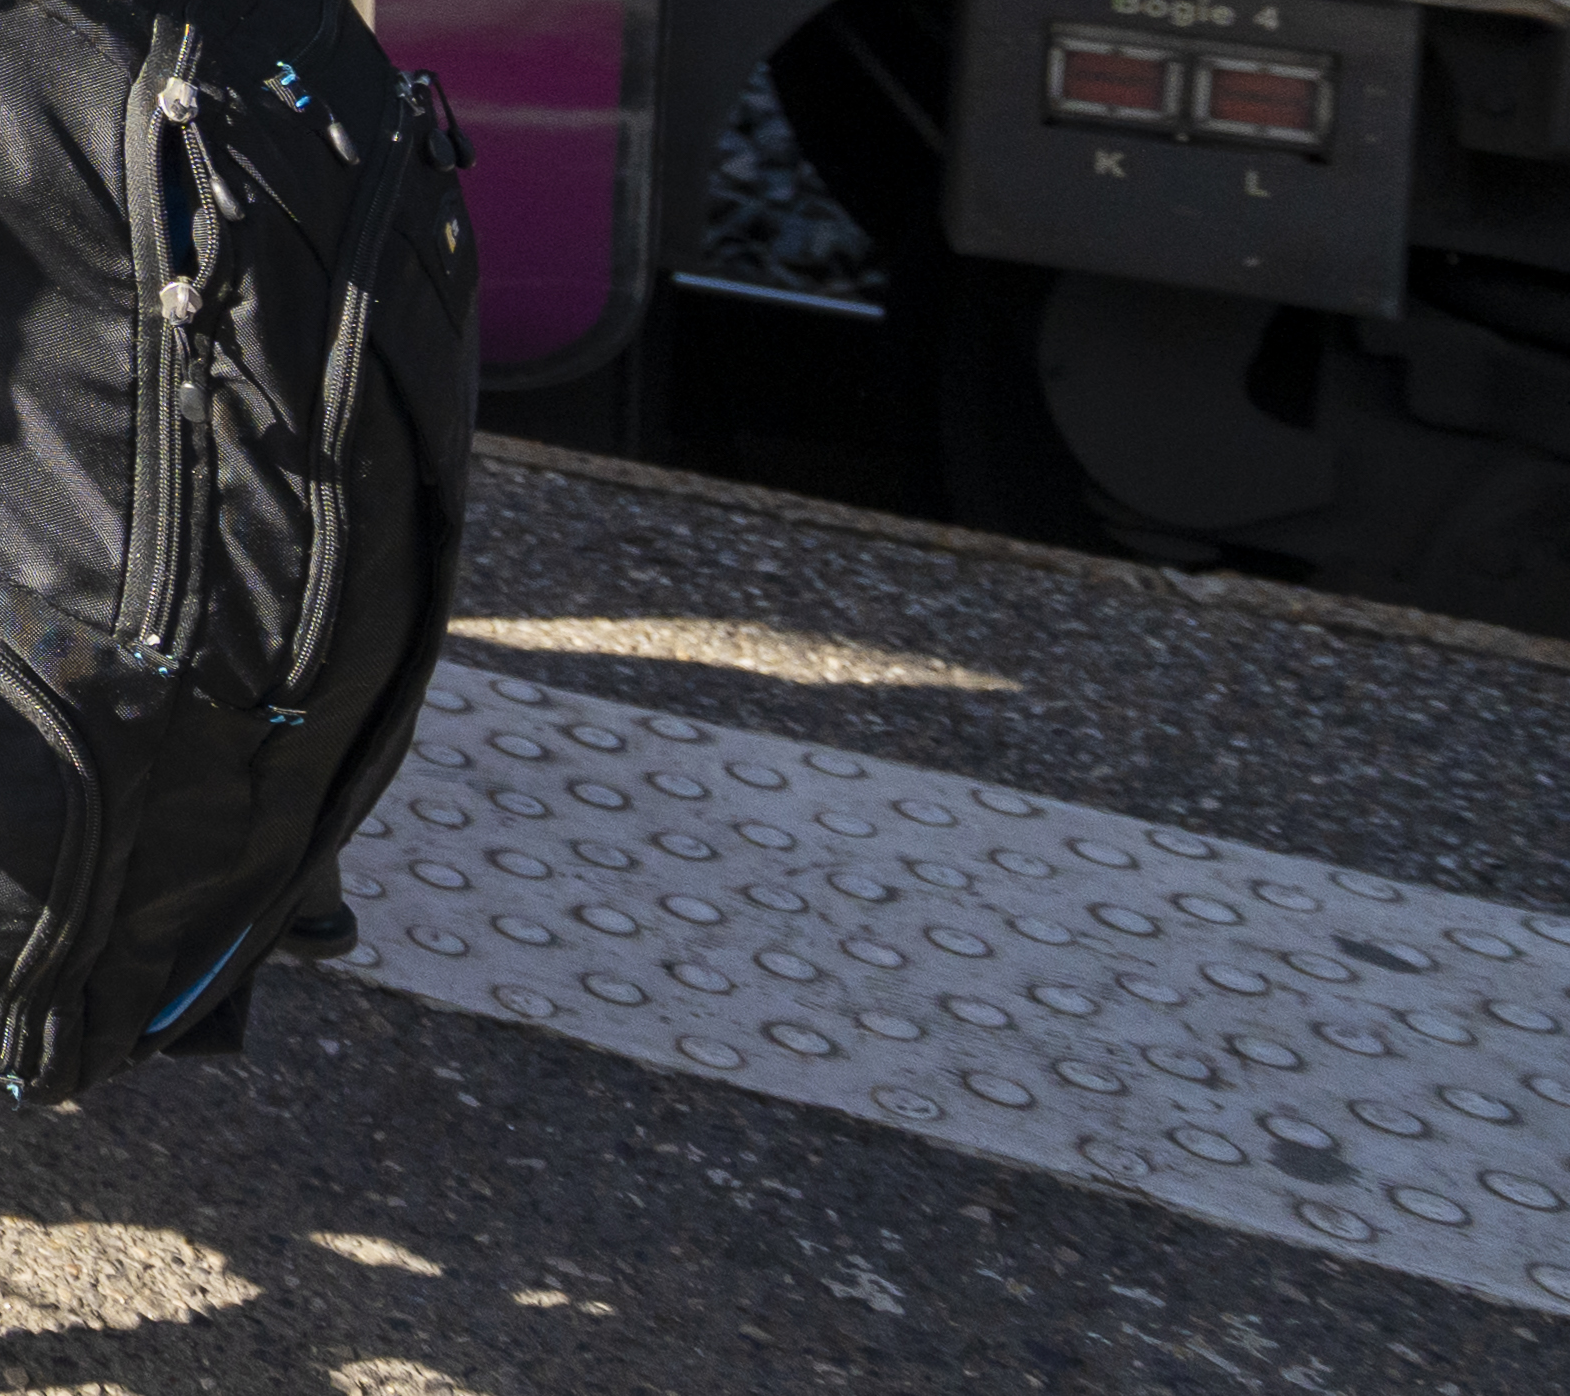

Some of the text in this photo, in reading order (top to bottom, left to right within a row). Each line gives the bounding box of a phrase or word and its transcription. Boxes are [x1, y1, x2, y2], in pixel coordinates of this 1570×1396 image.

[1252, 6, 1281, 31] 4
[1093, 149, 1272, 198] K L
